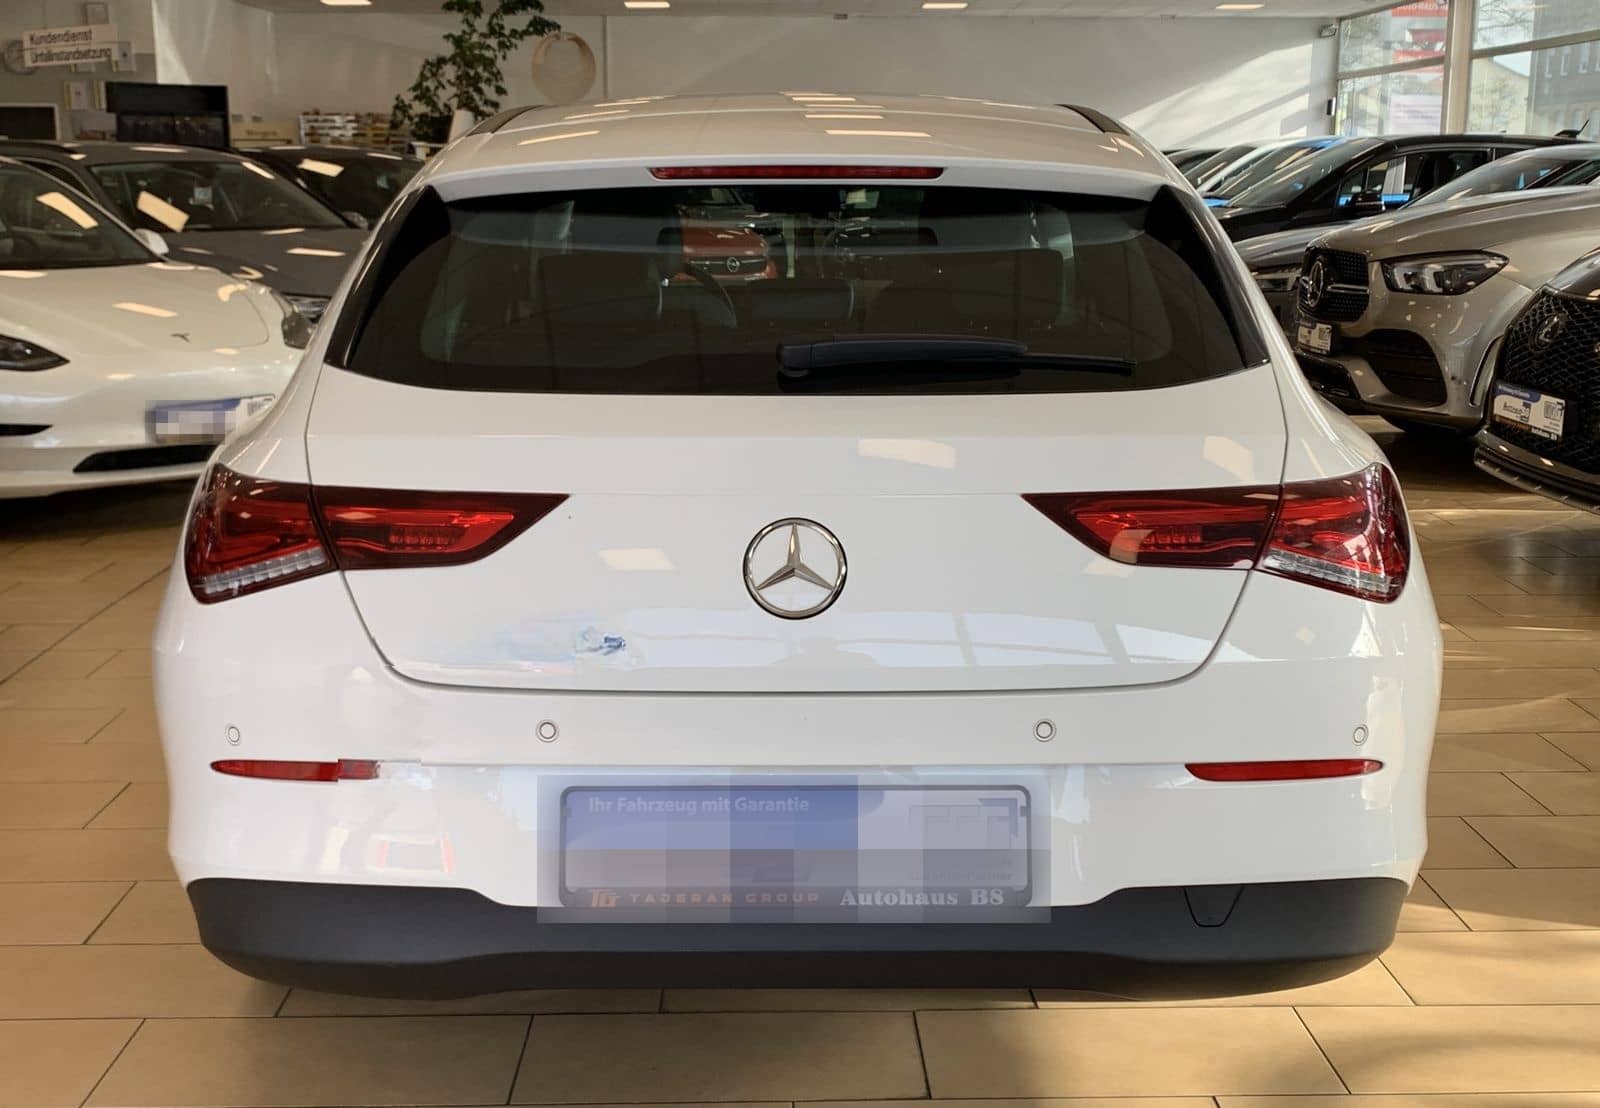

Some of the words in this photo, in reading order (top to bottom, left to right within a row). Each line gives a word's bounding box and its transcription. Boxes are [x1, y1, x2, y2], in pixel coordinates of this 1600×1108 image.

[29, 29, 93, 45] Kundendienst
[589, 796, 612, 812] Ihr
[617, 796, 697, 815] Fahrzeug
[702, 796, 730, 812] mit
[735, 796, 809, 812] Garantie
[744, 892, 819, 904] GROUP
[840, 888, 958, 905] Autohaus
